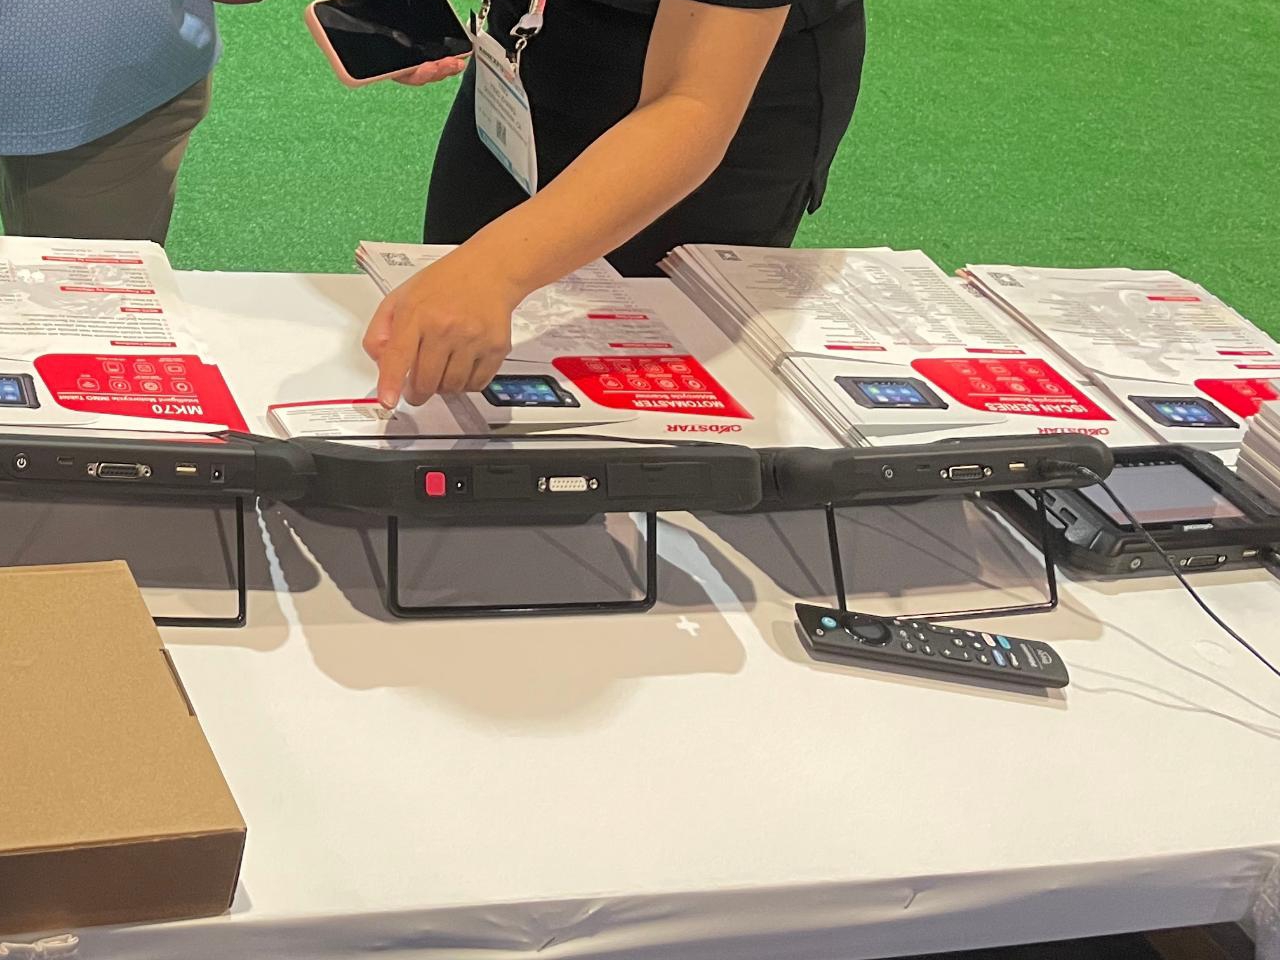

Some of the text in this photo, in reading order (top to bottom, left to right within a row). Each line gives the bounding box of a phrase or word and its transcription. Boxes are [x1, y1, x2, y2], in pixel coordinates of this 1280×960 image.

[112, 395, 157, 403] Motorcycle
[632, 399, 725, 409] MOTOMASTER
[151, 403, 204, 415] MK70
[984, 402, 1040, 412] SERIES
